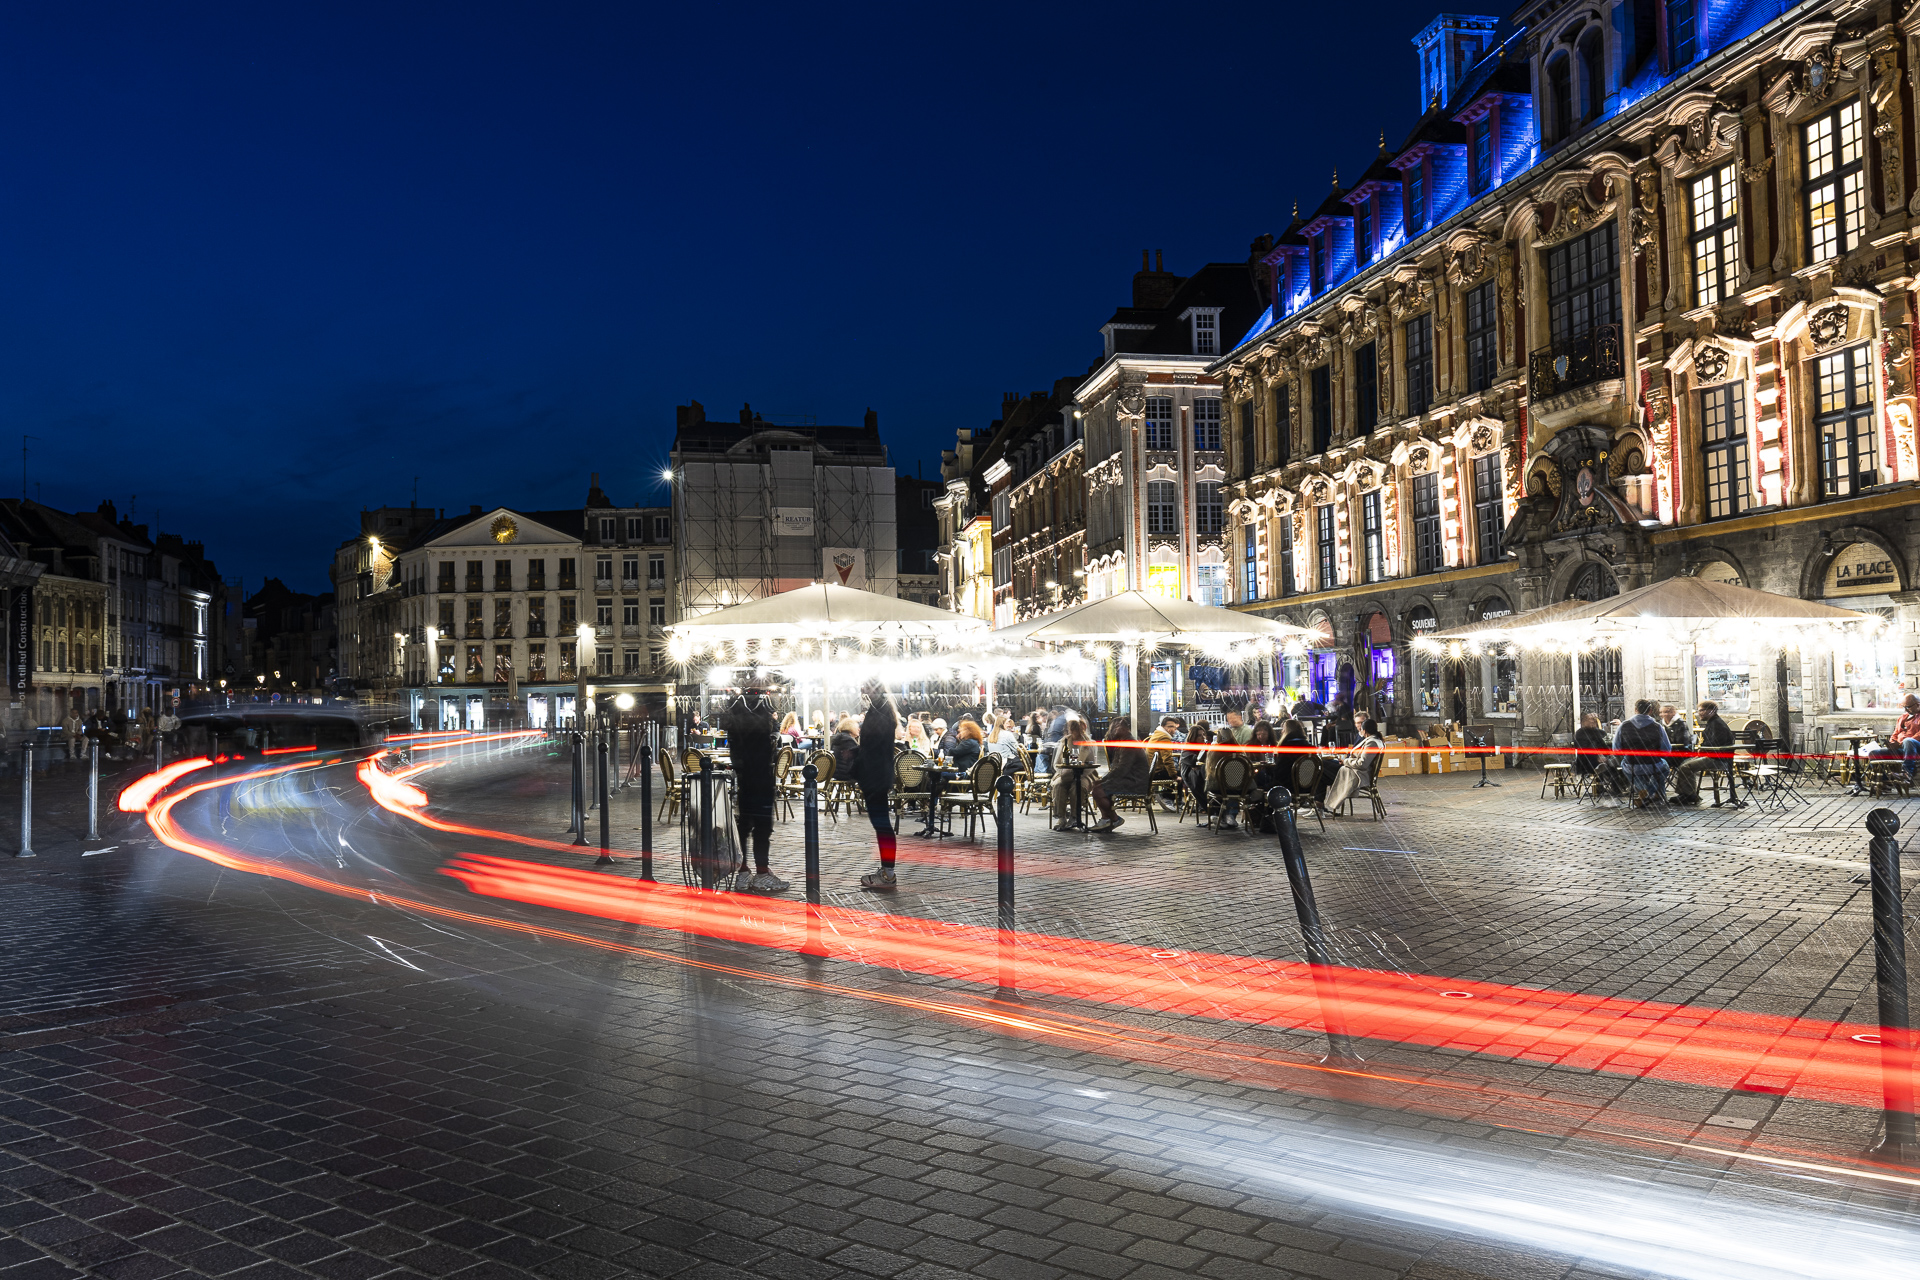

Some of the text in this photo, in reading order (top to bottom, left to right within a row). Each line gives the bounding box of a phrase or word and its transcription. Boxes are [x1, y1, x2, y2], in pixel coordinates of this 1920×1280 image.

[1837, 561, 1893, 578] LA PLACE
[18, 591, 27, 649] Construction
[18, 651, 27, 689] Dutilleul
